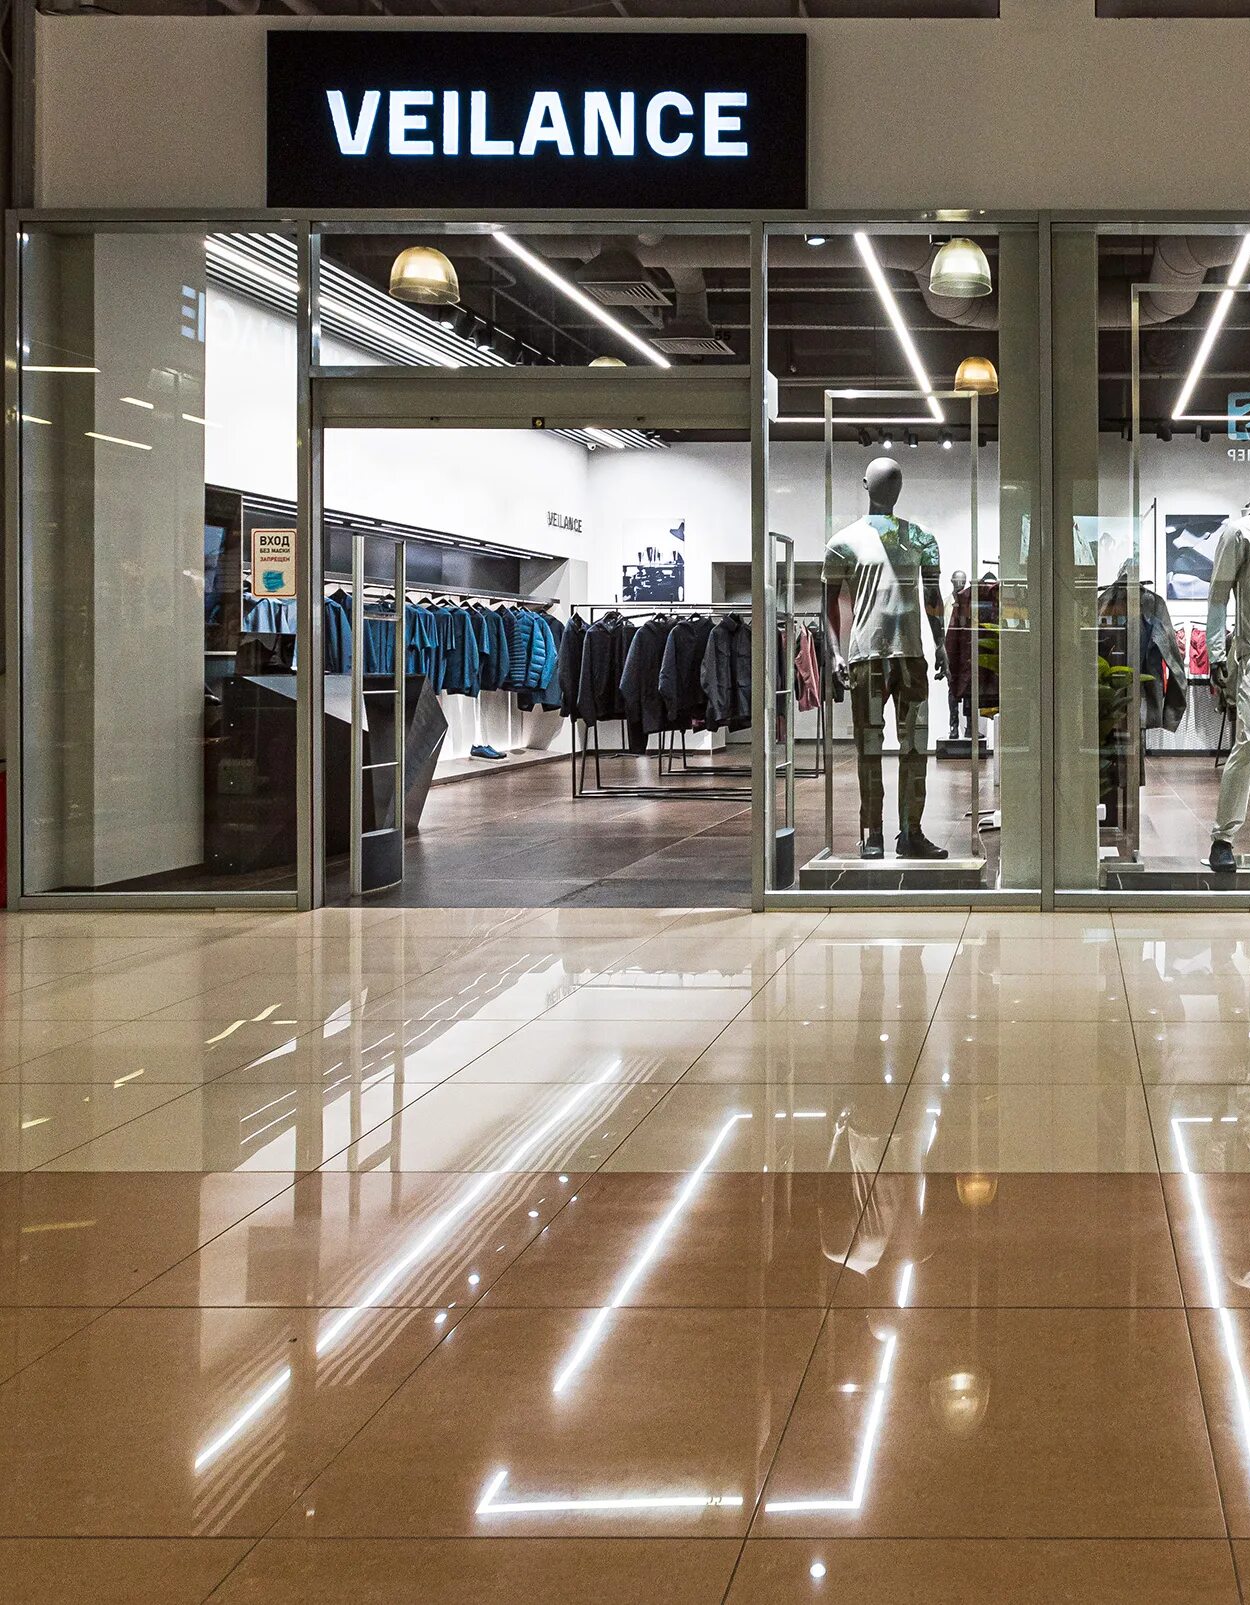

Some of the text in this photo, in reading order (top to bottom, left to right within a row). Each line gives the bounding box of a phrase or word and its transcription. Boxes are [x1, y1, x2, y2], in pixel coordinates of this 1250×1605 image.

[326, 90, 748, 156] VEILANCE
[547, 511, 583, 533] VEILANCE
[260, 536, 290, 547] ВХОД
